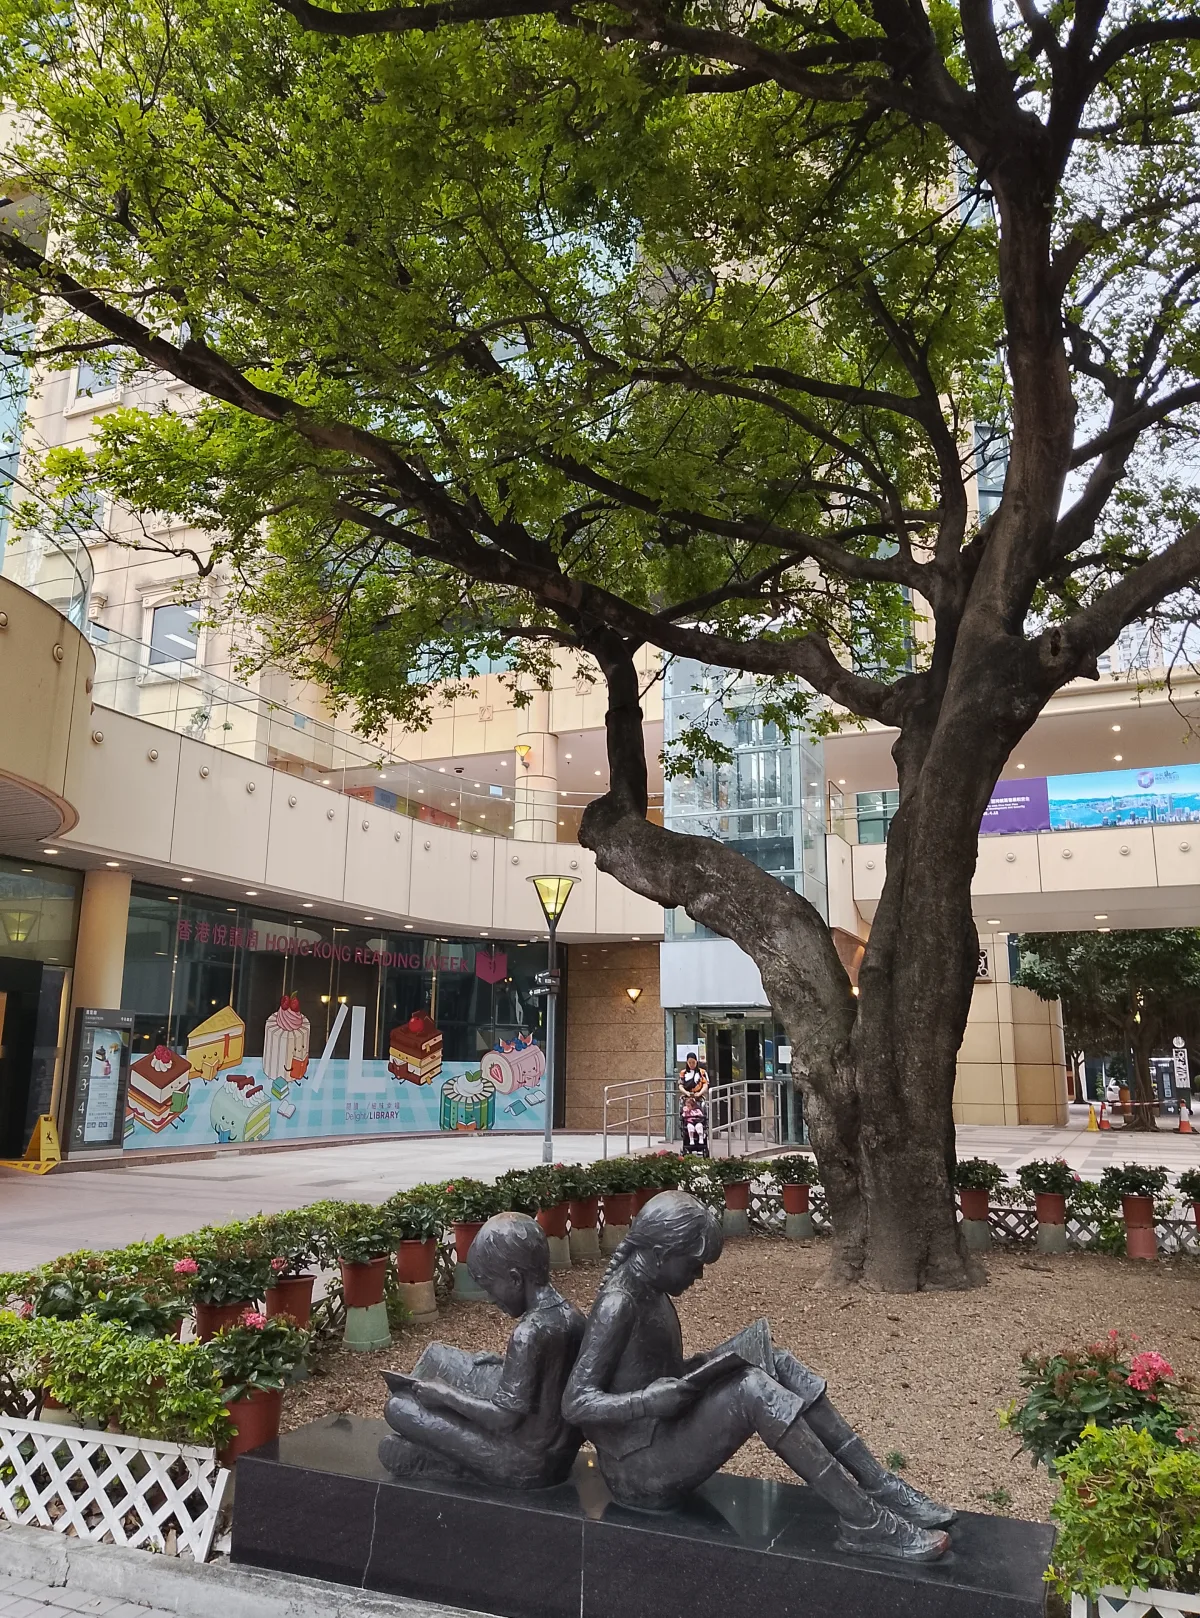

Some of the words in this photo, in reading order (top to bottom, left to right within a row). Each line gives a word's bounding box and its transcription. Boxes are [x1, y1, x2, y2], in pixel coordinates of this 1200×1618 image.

[178, 919, 259, 950] 香港悅讀周
[266, 933, 310, 956] HONG
[313, 941, 351, 962] KONG
[354, 947, 421, 969] READING
[424, 955, 470, 972] WEEK
[83, 1055, 89, 1067] 2
[80, 1078, 88, 1090] 3
[78, 1101, 85, 1114] 4
[76, 1125, 82, 1138] 5
